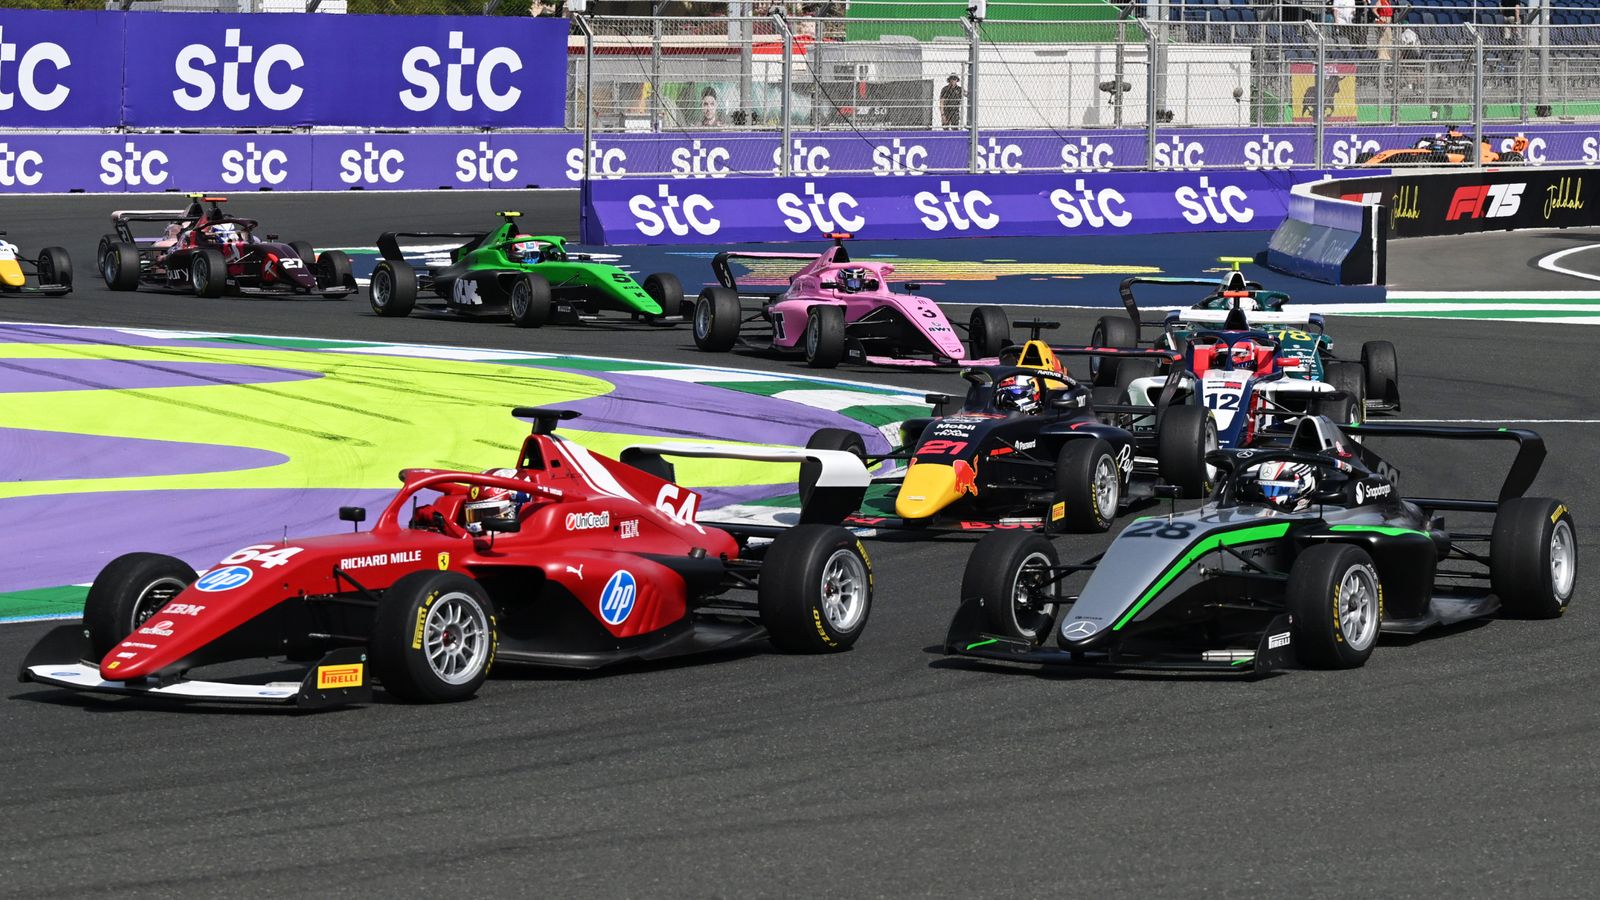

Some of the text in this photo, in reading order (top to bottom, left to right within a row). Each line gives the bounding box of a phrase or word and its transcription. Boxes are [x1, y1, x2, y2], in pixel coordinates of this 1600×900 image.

[0, 25, 71, 111] tc
[172, 28, 305, 112] stc
[399, 31, 523, 112] stc
[0, 142, 43, 186] tc
[100, 142, 169, 186] stc
[221, 142, 288, 185] stc
[340, 141, 405, 184] stc
[455, 141, 518, 182] stc
[566, 140, 627, 181] stc
[671, 139, 730, 178] stc
[872, 138, 928, 176] stc
[1061, 137, 1114, 173] stc
[1154, 135, 1204, 171] stc
[1243, 134, 1294, 169] stc
[628, 184, 721, 237] stc
[776, 182, 866, 234] stc
[914, 180, 1000, 232] stc
[1050, 179, 1132, 228] stc
[1175, 176, 1254, 225] stc
[280, 258, 303, 271] 27
[611, 273, 632, 283] 5
[1204, 393, 1241, 411] 12
[936, 423, 977, 431] Mobil
[915, 440, 969, 456] 21
[574, 511, 610, 530] UniCredit
[655, 483, 706, 535] 64
[619, 519, 640, 539] IBM
[1120, 520, 1197, 540] 28
[220, 545, 304, 569] 64
[340, 550, 422, 570] RICHARD MILLE
[199, 566, 250, 591] hp
[603, 570, 635, 624] hp
[161, 603, 206, 616] IBM
[812, 608, 831, 643] ZERO
[1268, 631, 1291, 650] PIRELLI
[321, 668, 359, 684] PIRELLI
